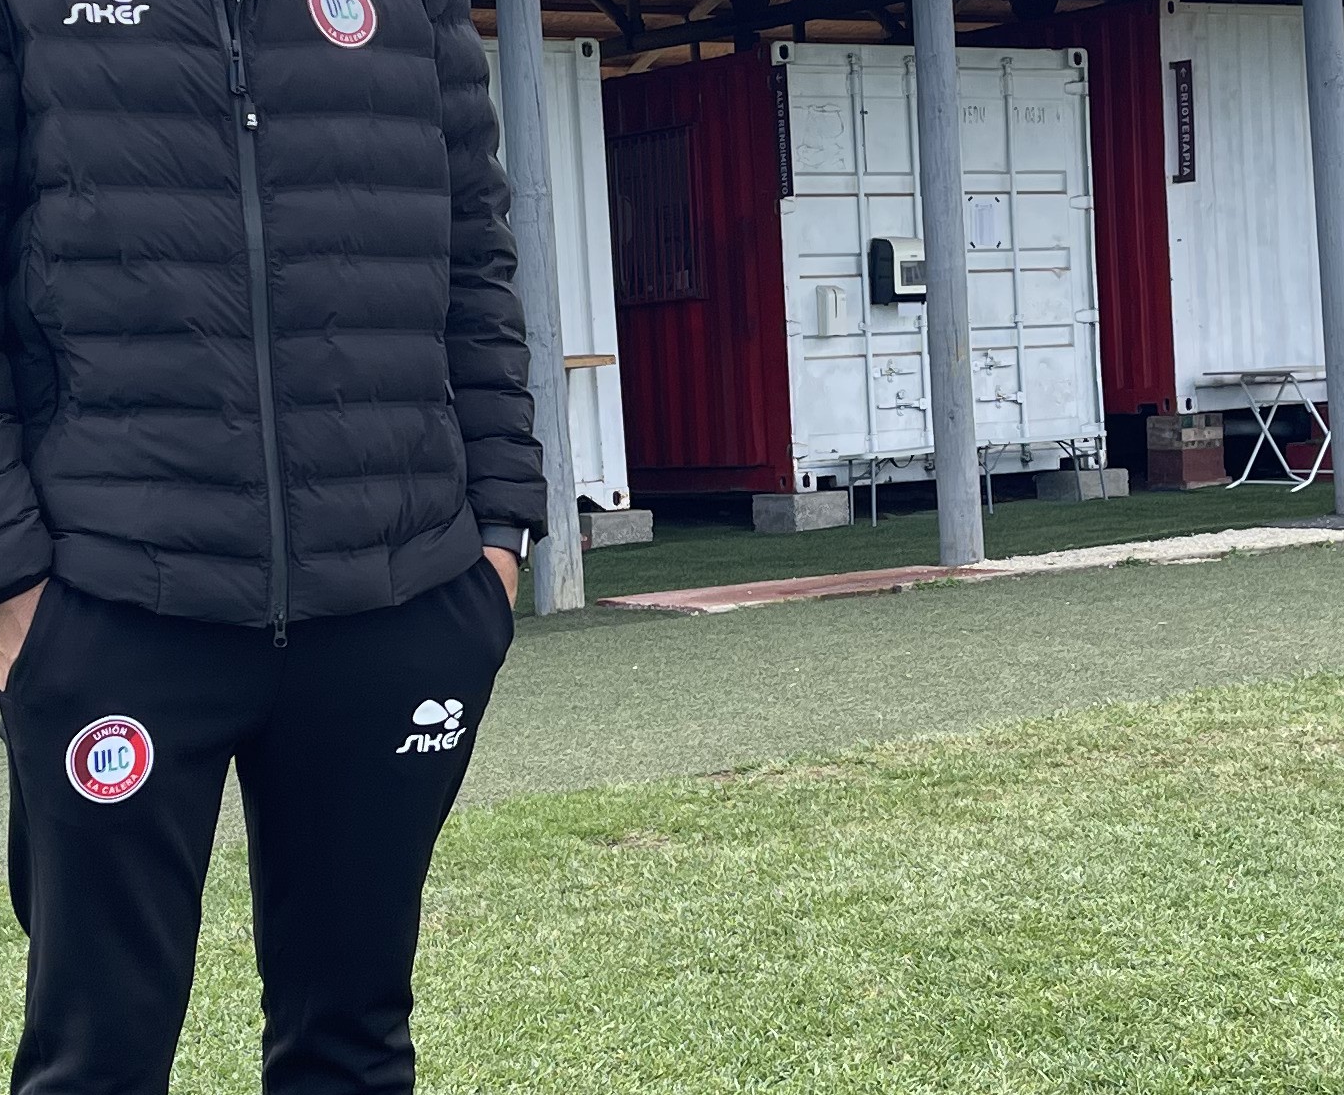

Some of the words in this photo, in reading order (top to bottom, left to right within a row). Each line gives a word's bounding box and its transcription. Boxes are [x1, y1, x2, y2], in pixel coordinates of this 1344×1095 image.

[339, 29, 367, 43] CALERA
[776, 90, 785, 117] ALTO
[1180, 83, 1191, 176] CRIOTERAPIA
[778, 119, 789, 195] RENDIMIENTO
[92, 724, 128, 740] UNIÓN
[94, 746, 129, 773] ULC
[86, 779, 99, 792] LA
[101, 774, 139, 794] CALERA
